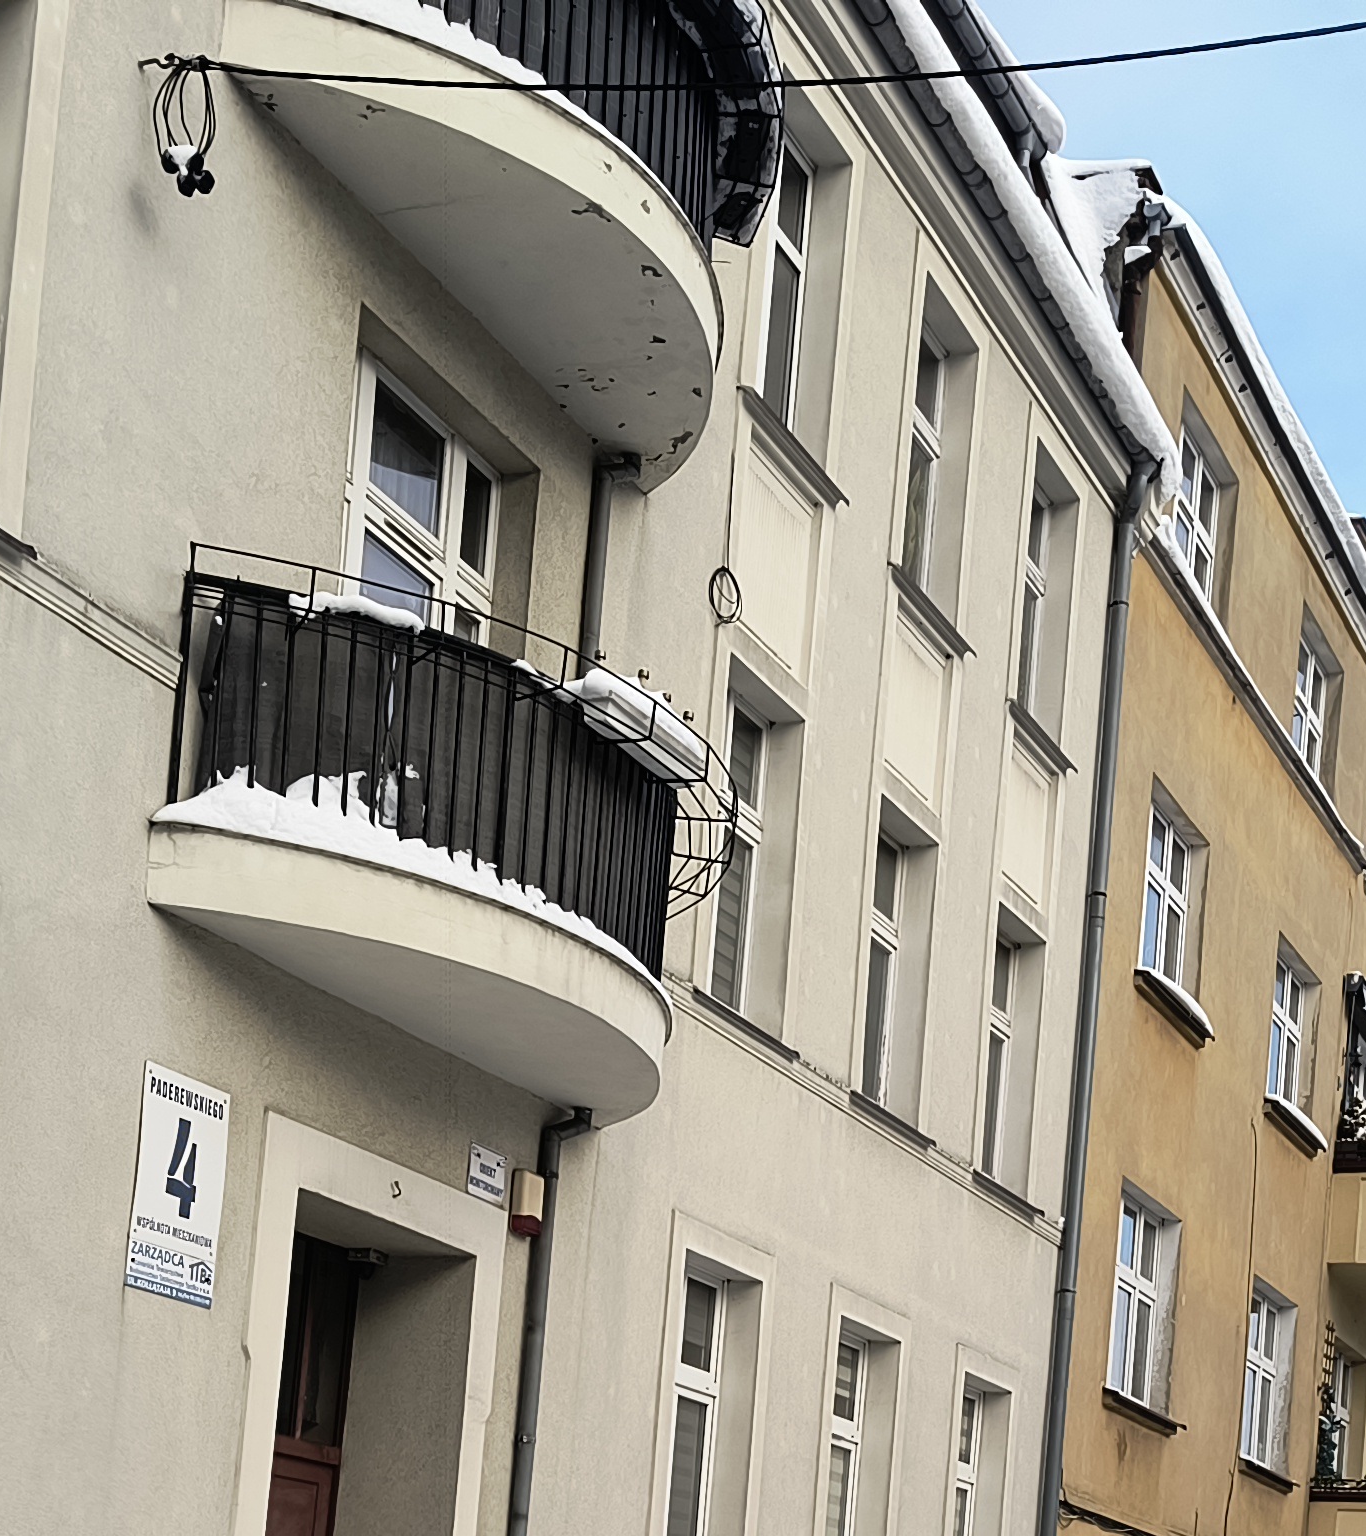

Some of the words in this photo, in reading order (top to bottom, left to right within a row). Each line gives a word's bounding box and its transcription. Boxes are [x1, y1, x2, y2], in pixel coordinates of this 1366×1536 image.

[150, 1076, 224, 1121] PADEREWSKIEGO
[165, 1117, 197, 1219] 4
[131, 1240, 185, 1267] ZARZĄDCA
